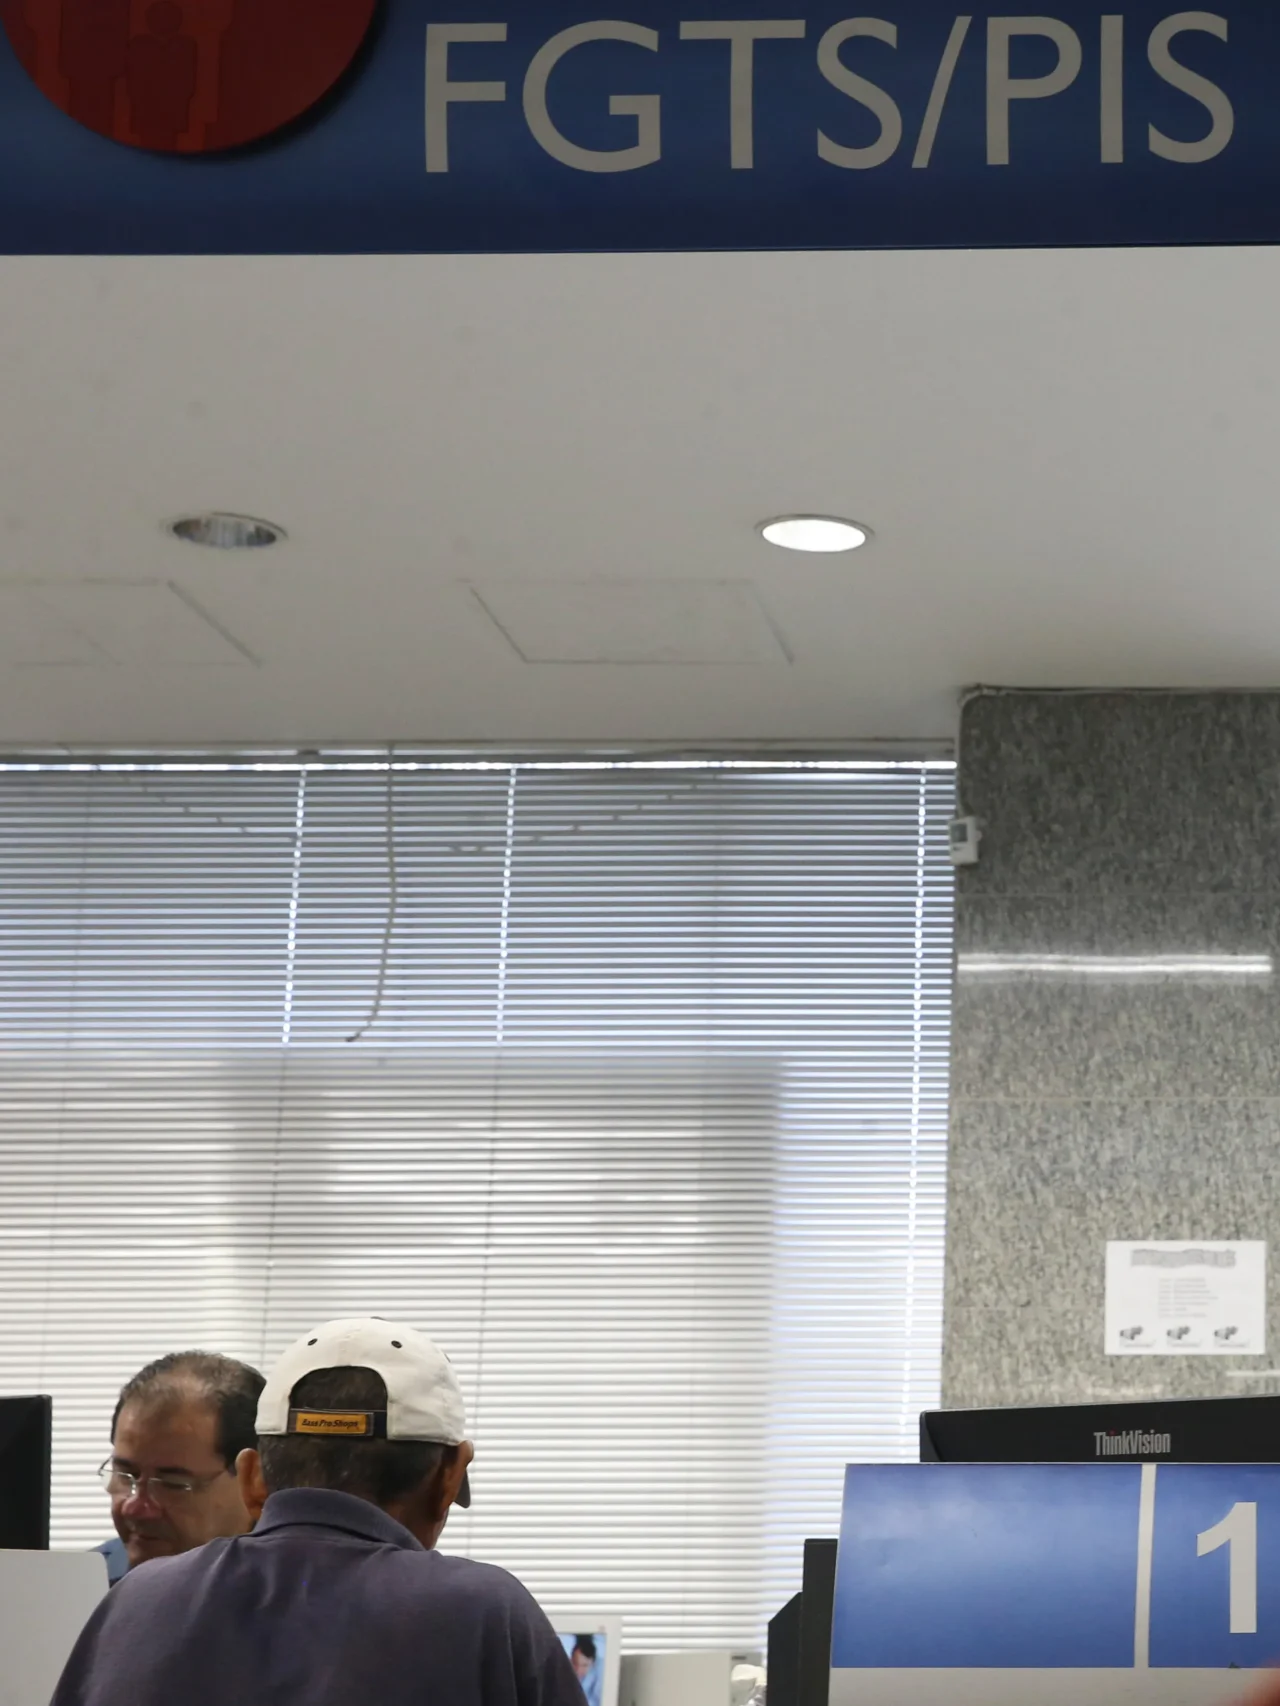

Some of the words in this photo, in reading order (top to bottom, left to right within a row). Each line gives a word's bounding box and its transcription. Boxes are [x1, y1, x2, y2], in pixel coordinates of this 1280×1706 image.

[423, 11, 1237, 174] FGTS/PIS
[319, 1419, 332, 1427] Pro
[332, 1419, 359, 1430] Shops
[1093, 1430, 1171, 1456] ThinkVision
